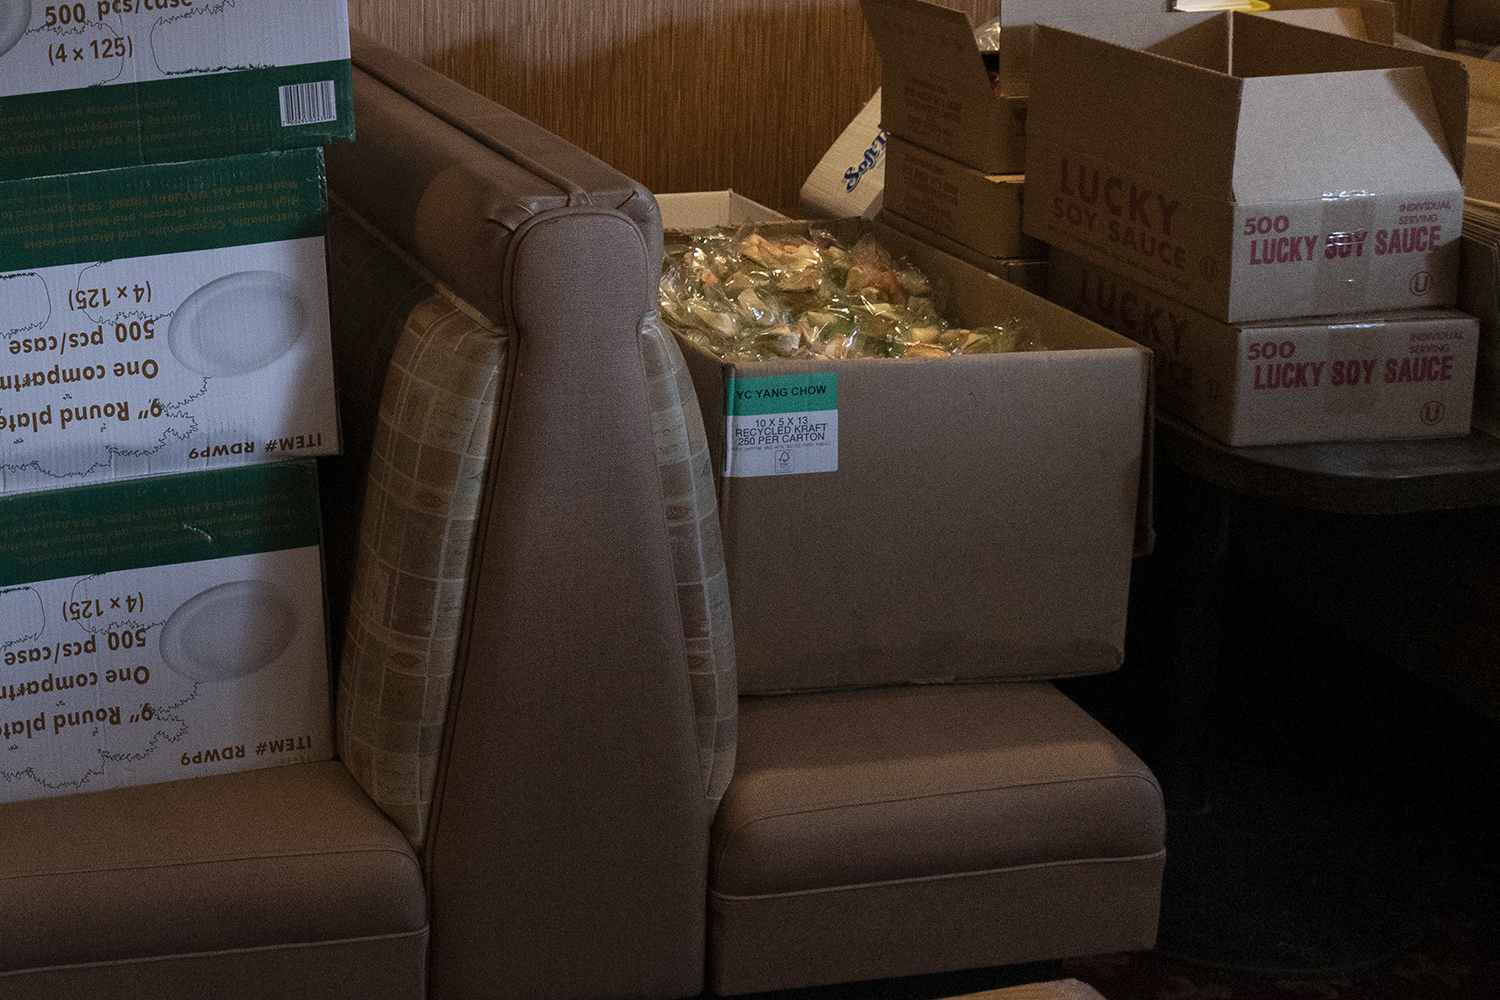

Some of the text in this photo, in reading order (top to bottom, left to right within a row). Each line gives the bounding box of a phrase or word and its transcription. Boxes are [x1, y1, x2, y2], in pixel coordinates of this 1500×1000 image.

[1400, 200, 1451, 212] INDIVIDUAL
[1243, 215, 1290, 235] 500
[1399, 213, 1438, 225] SERVING
[1249, 225, 1442, 266] LUCKY SOY SAUCE
[1248, 340, 1296, 360] 500
[113, 358, 160, 380] One
[1254, 355, 1453, 390] LUCKY SOY SAUCE
[736, 385, 827, 399] YC YANG CHOW
[735, 422, 827, 438] RECYCLED KRAFT
[738, 433, 826, 446] 250 PER CARTON
[180, 735, 313, 767] ITEM# RDWP9
